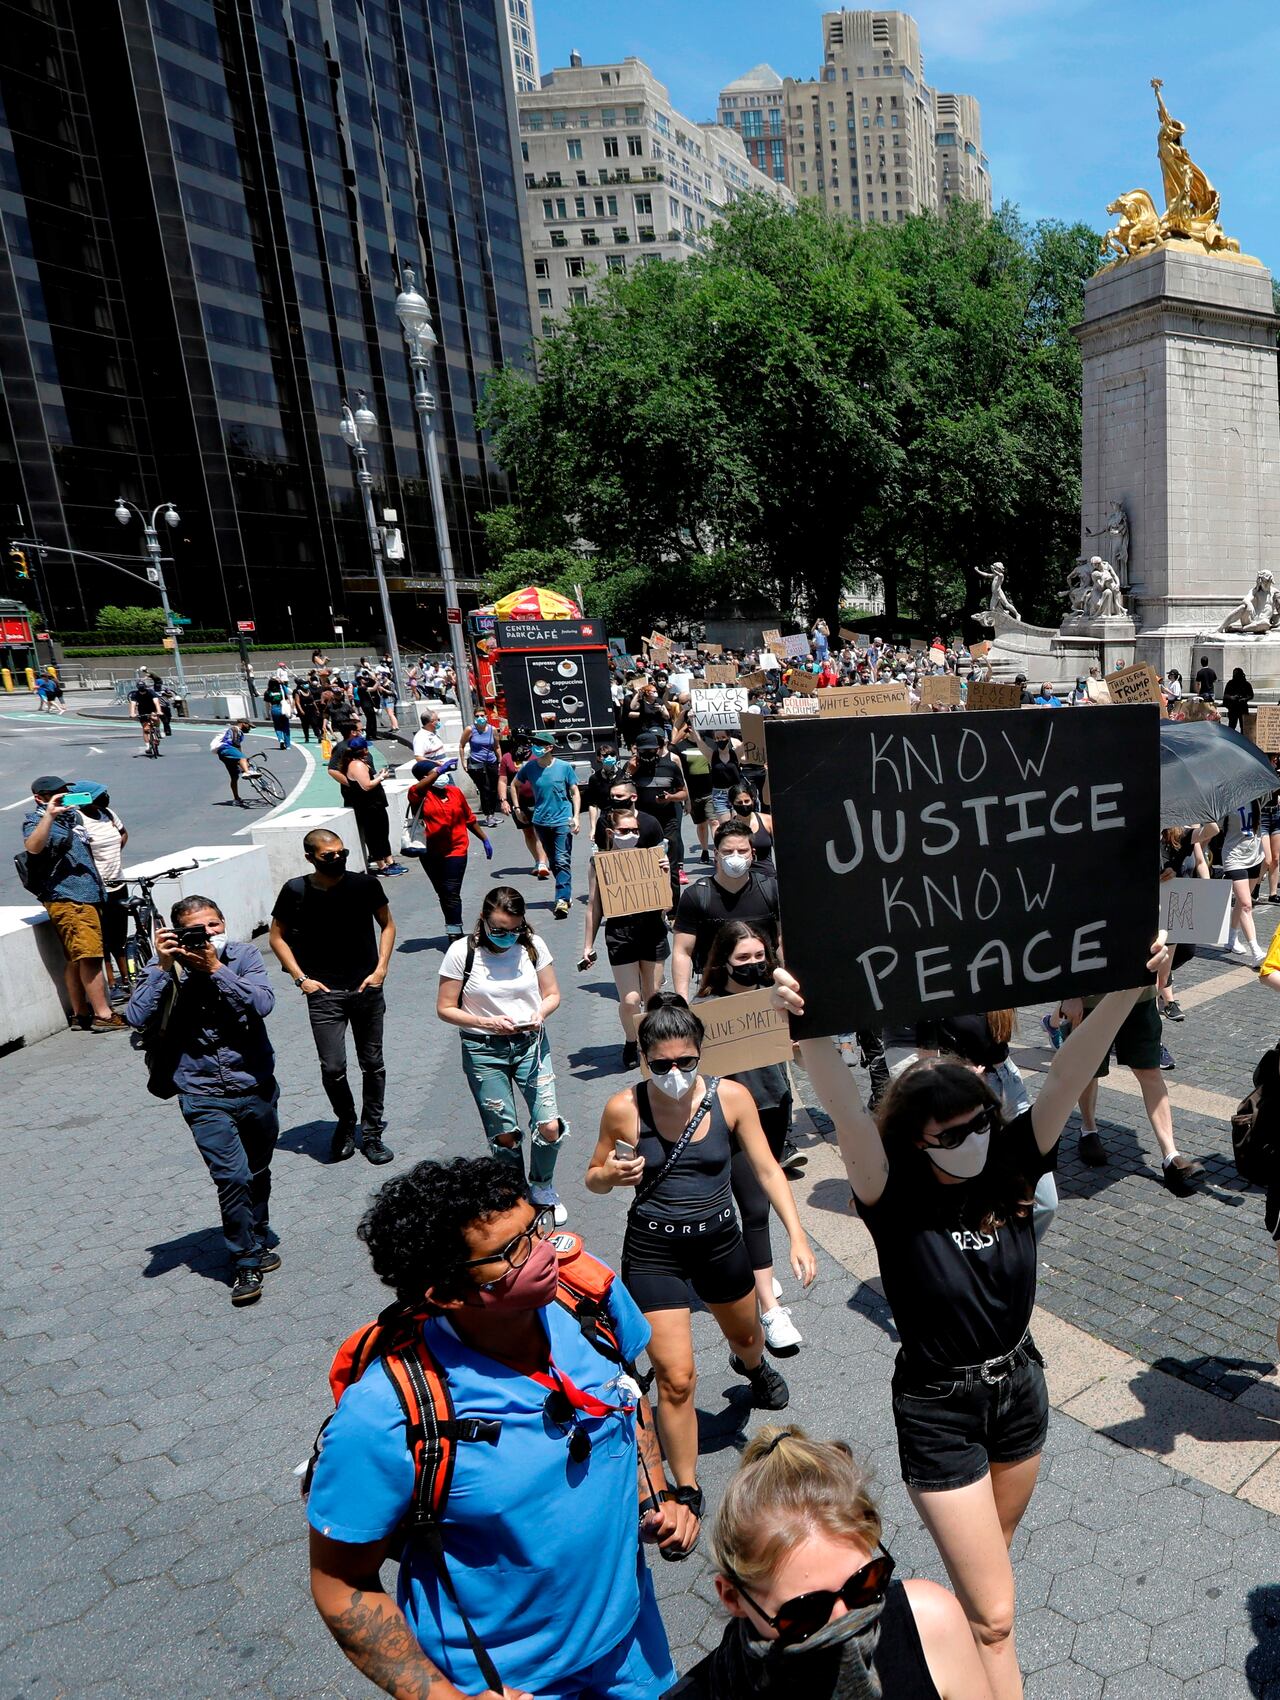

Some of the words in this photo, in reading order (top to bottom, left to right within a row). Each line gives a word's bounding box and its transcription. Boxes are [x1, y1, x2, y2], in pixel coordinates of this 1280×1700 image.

[527, 628, 559, 640] CAFÉ
[582, 626, 593, 636] illy
[1109, 678, 1125, 690] THIS
[1133, 671, 1147, 680] FOR
[1115, 677, 1150, 699] TRUMP
[695, 688, 746, 701] BLACK
[819, 698, 850, 711] WHITE
[852, 692, 906, 707] SUPREMACY
[1127, 695, 1139, 703] BIG
[1138, 689, 1151, 698] FAT
[695, 701, 743, 713] LIVES
[694, 712, 741, 728] MATTE
[870, 721, 1054, 794] KNOW
[825, 782, 1126, 875] JUSTICE
[598, 851, 637, 886] BLACK
[633, 848, 663, 880] LIVES
[606, 880, 662, 915] MATTER
[881, 862, 1056, 934] KNOW
[856, 919, 1108, 1012] PEACE
[710, 1016, 746, 1040] LIVES
[648, 1221, 707, 1234] CORE
